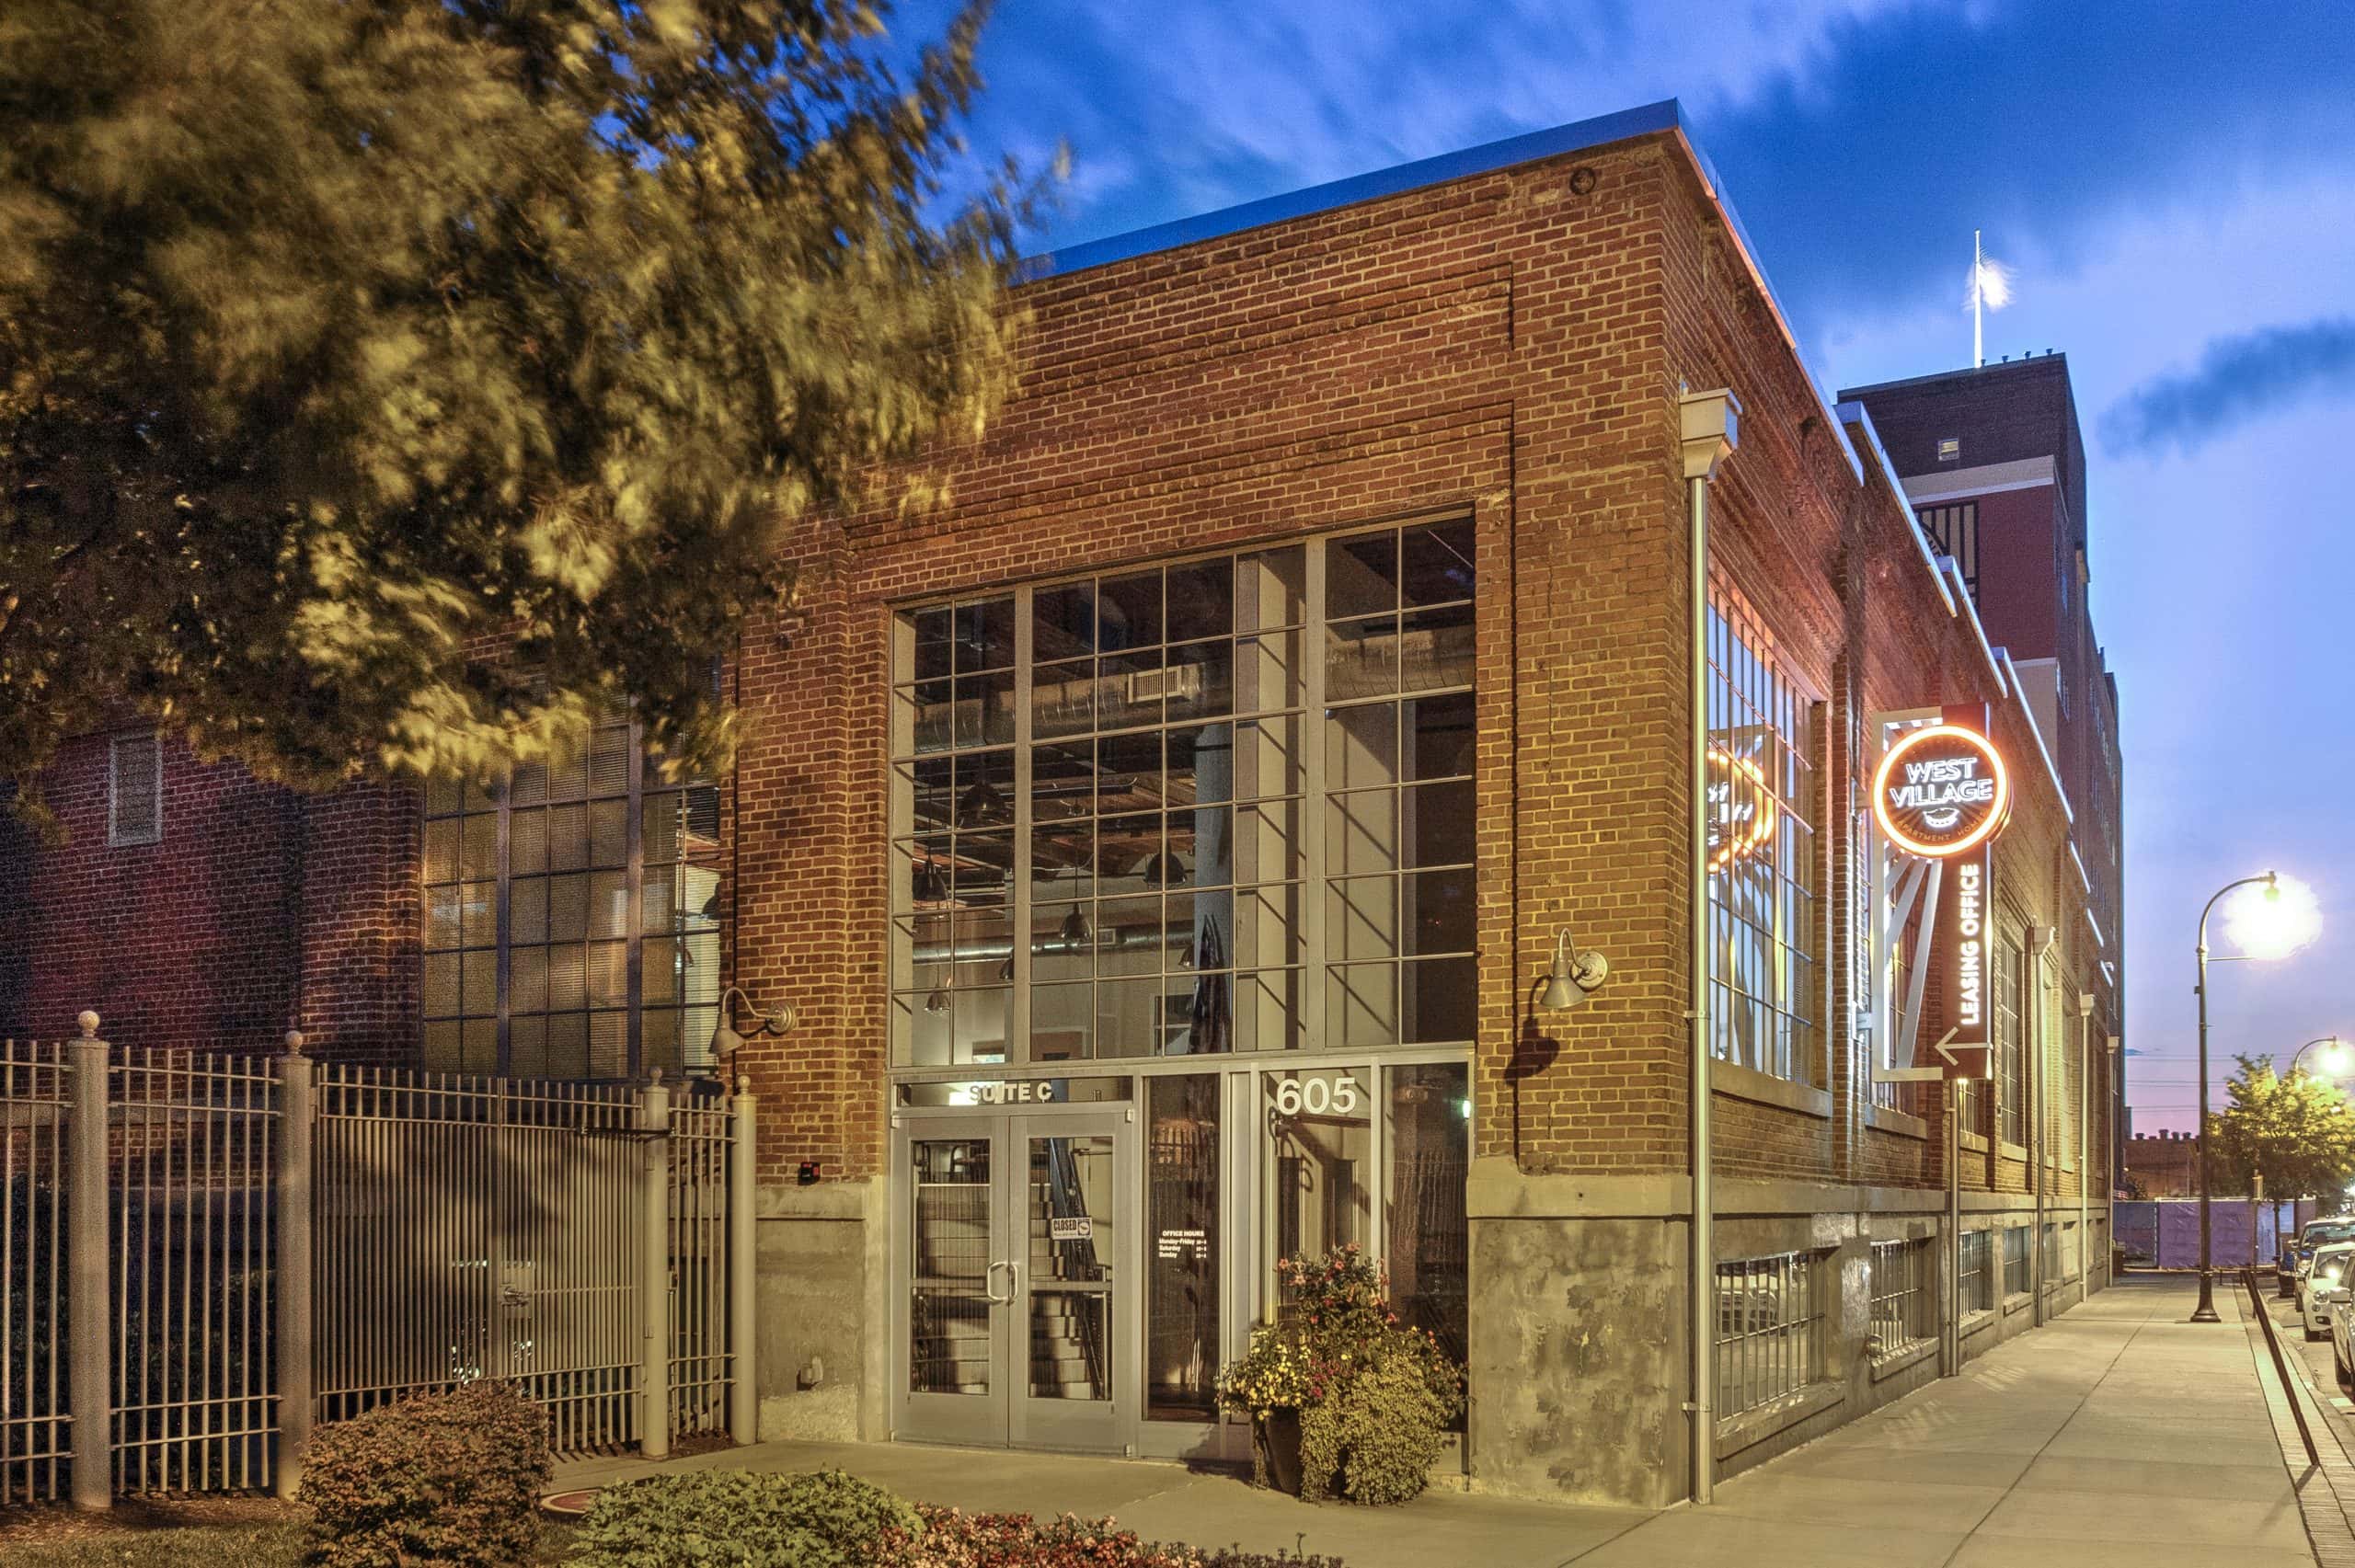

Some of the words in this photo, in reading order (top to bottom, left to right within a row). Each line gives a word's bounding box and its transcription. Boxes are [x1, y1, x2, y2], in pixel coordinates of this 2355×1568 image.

[1905, 757, 1978, 784] WEST
[1889, 778, 1993, 808] VILLAGE
[1959, 864, 1980, 936] OFFICE
[1959, 940, 1980, 1025] LEASING
[970, 1083, 1030, 1103] SUITE
[1037, 1082, 1052, 1101] C
[1277, 1078, 1356, 1115] 605
[1053, 1219, 1077, 1231] CLOSED
